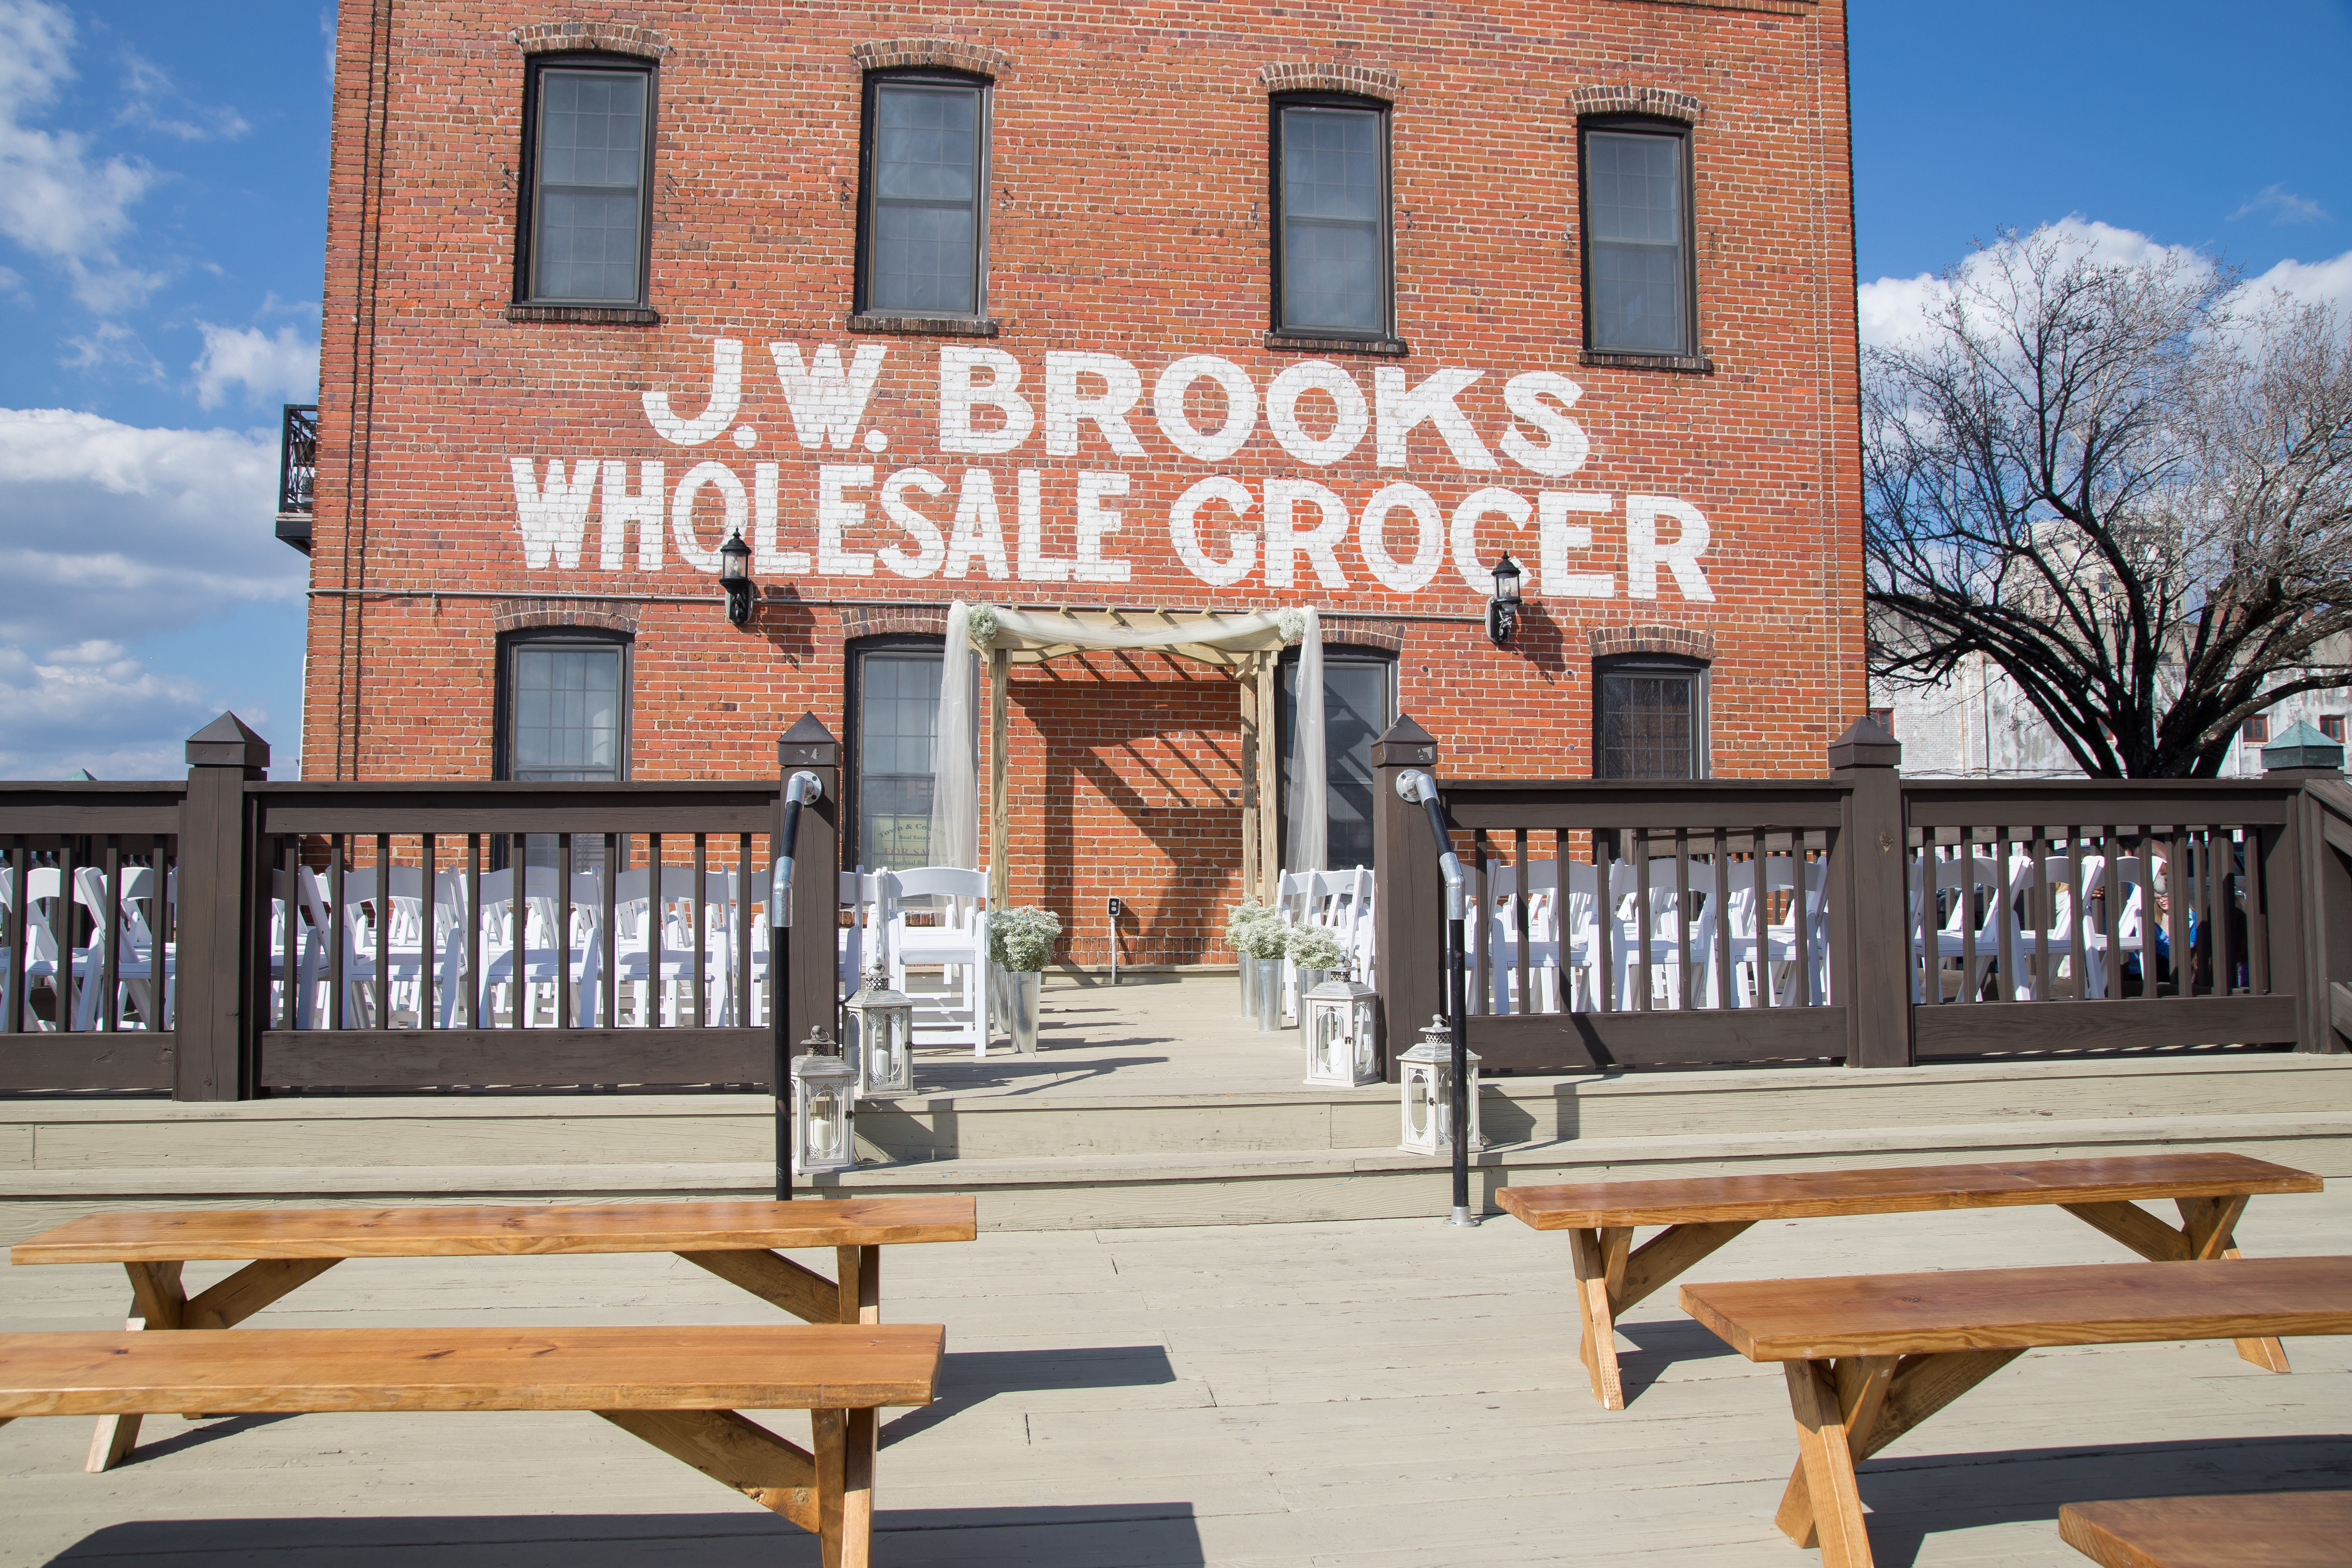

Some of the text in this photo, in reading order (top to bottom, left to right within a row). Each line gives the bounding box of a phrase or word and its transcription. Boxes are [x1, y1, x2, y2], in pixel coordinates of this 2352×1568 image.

[642, 339, 1591, 478] J.W. BROOKS
[510, 458, 1715, 602] WHOLESALE GROCER
[877, 825, 903, 838] Town
